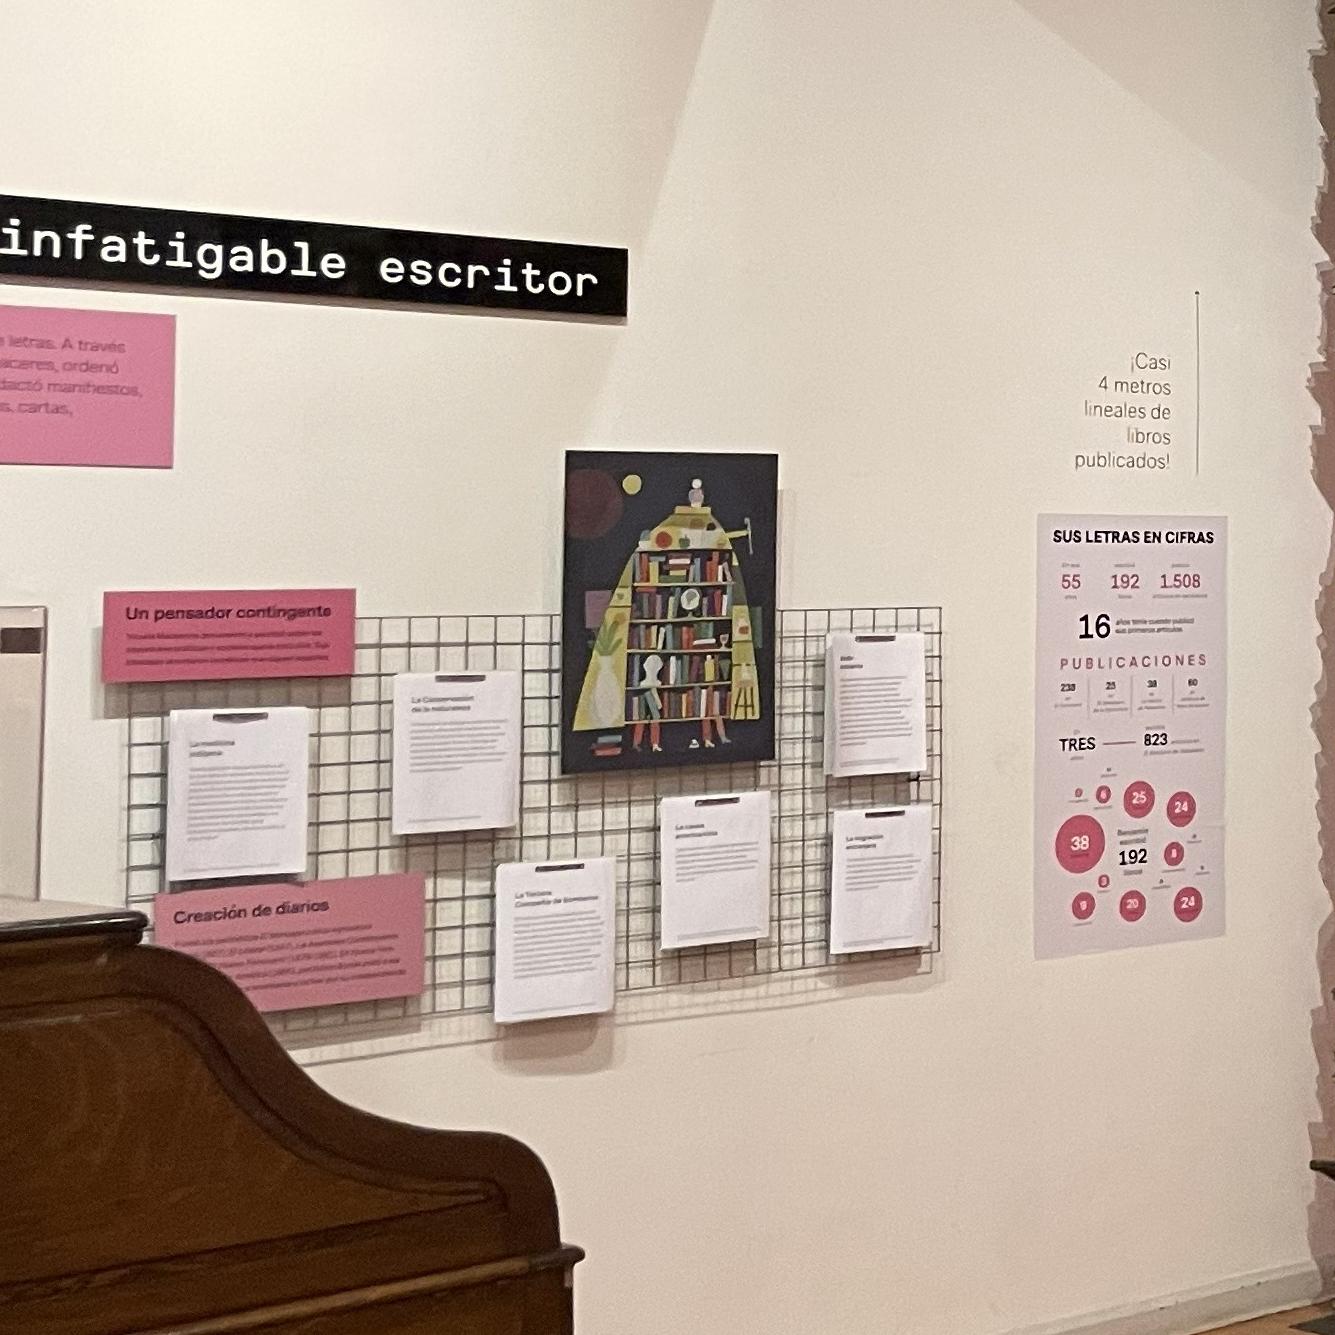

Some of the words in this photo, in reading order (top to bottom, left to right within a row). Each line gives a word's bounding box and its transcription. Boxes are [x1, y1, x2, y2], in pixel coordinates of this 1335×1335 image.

[0, 217, 347, 279] infatigable
[380, 255, 599, 297] escritor
[61, 337, 73, 349] A
[1130, 351, 1172, 374] ¡Casi
[1098, 375, 1109, 391] 4
[1114, 379, 1172, 396] metros
[1084, 399, 1147, 419] lineales
[1150, 403, 1172, 420] de
[1127, 426, 1172, 446] libros
[1074, 451, 1171, 472] publicados!
[1053, 529, 1083, 544] SUS
[1085, 530, 1141, 544] LETRAS
[1143, 531, 1162, 544] EN
[1165, 531, 1214, 544] CIFRAS
[1061, 574, 1081, 590] 55
[1111, 574, 1140, 590] 192
[1160, 573, 1201, 589] 1.508
[125, 606, 150, 621] Un
[153, 606, 232, 622] pensador
[236, 605, 333, 621] contingente
[1078, 613, 1112, 640] 16
[1060, 654, 1207, 670] PUBLICACIONES
[1059, 737, 1096, 751] TRES
[1144, 733, 1168, 747] 823
[1174, 801, 1188, 814] 24
[1070, 835, 1090, 851] 38
[1119, 848, 1148, 866] 192
[173, 903, 248, 925] Creación
[251, 904, 272, 918] de
[275, 900, 330, 915] diarios
